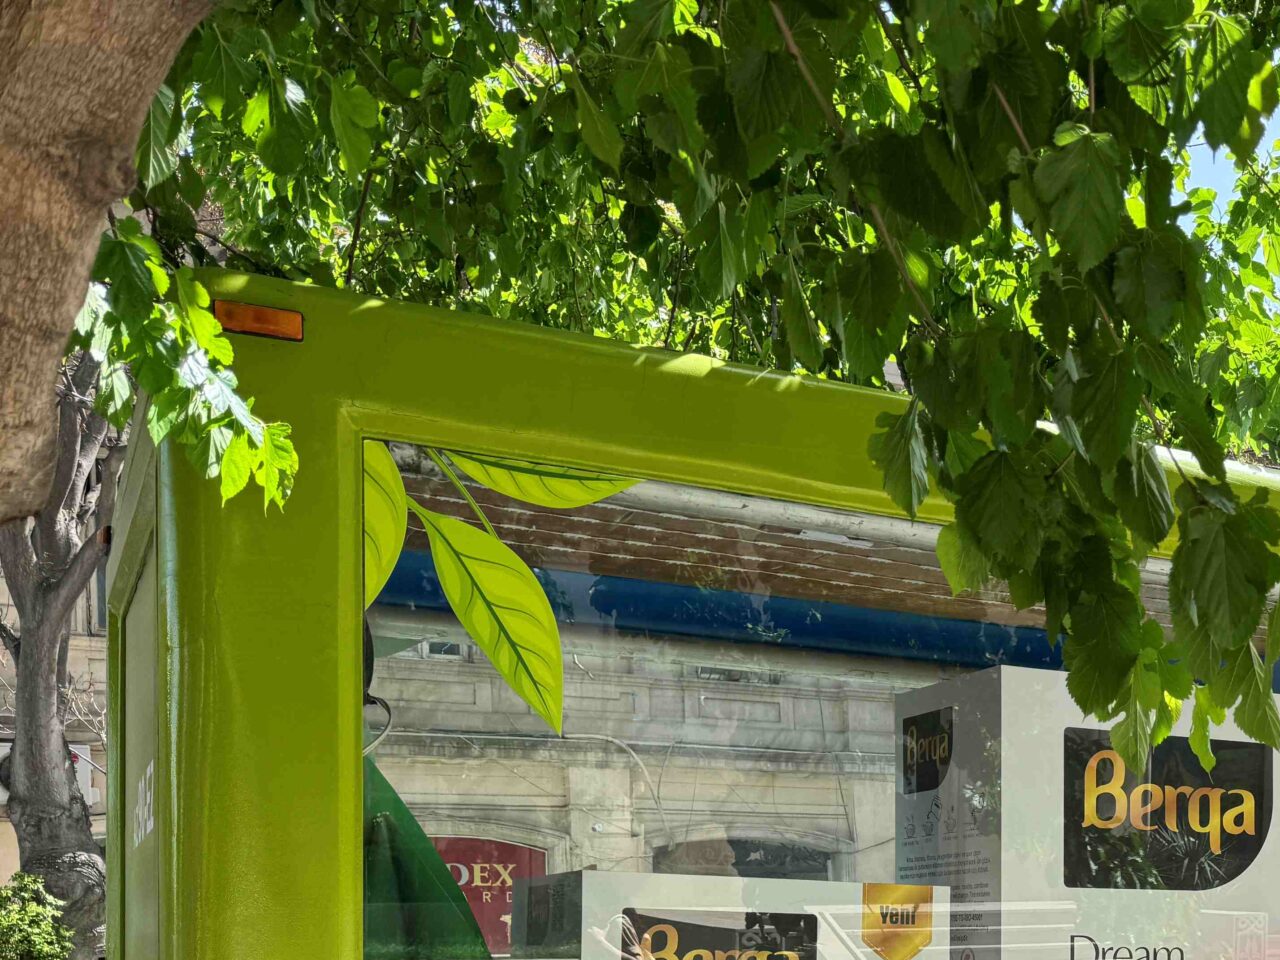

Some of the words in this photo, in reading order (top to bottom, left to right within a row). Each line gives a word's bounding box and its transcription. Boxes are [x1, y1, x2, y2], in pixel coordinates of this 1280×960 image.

[906, 725, 949, 769] Berqa
[1081, 749, 1256, 855] Berqa
[880, 905, 917, 925] Yeni
